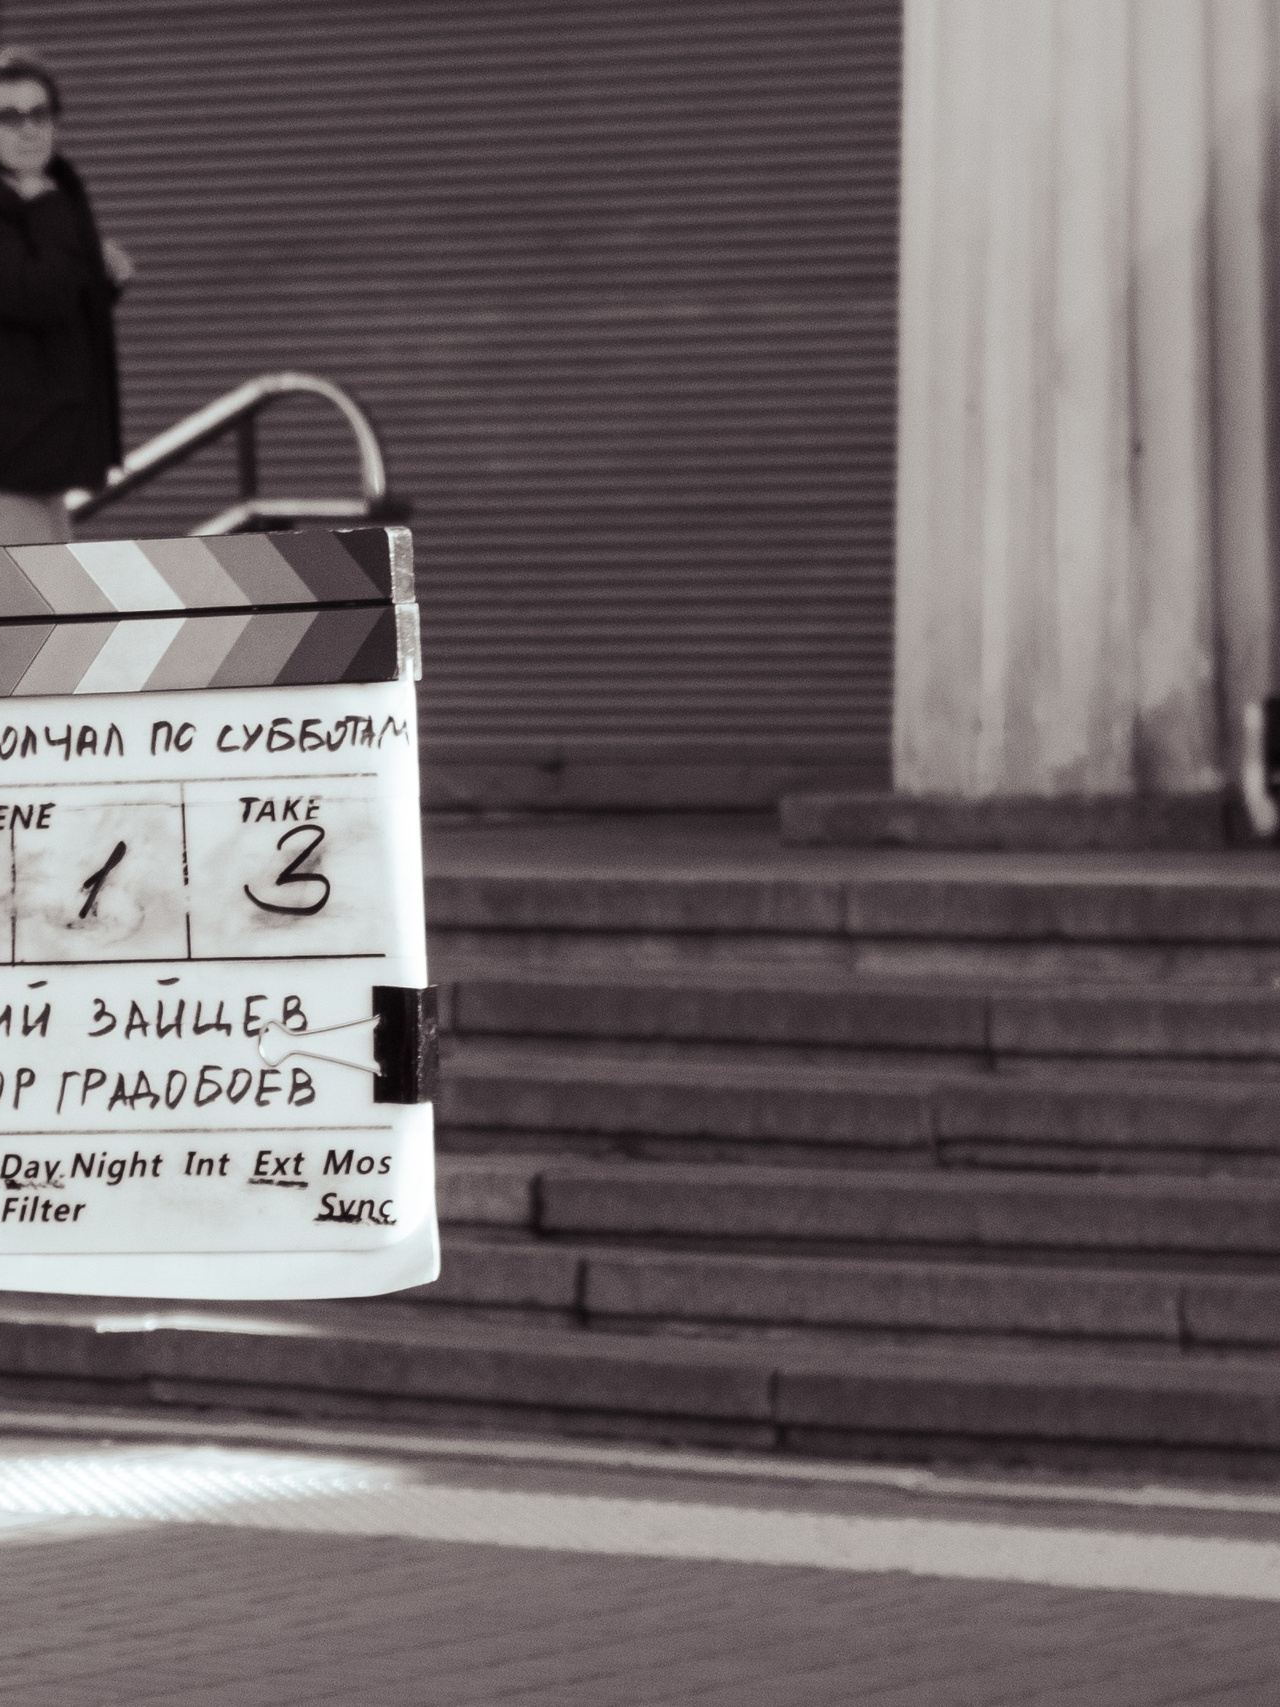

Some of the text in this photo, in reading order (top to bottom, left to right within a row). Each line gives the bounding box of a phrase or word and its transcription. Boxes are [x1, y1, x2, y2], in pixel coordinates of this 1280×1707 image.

[151, 721, 196, 756] ПО
[216, 714, 410, 753] СУББОТАМ
[239, 796, 323, 823] TAKE
[81, 840, 127, 919] 1
[244, 824, 331, 917] 3
[88, 977, 308, 1040] ЗАЙЦЕВ
[56, 1065, 316, 1114] ГРАДОБОЕВ
[0, 1149, 392, 1186] Day Night Int Ext Mos
[1, 1196, 86, 1223] Filter
